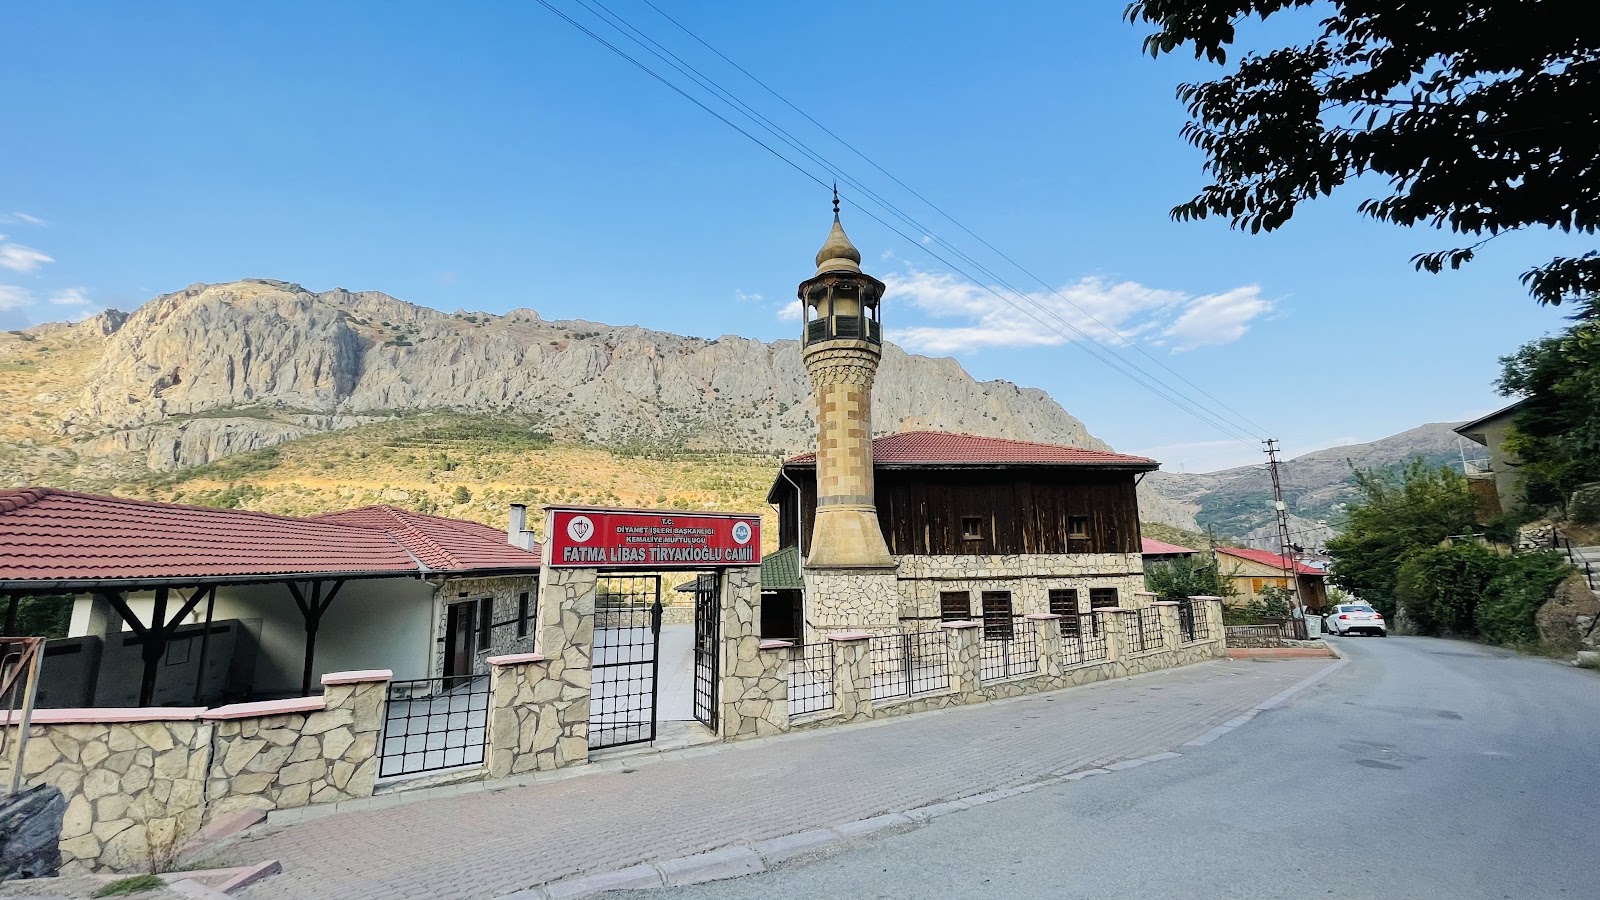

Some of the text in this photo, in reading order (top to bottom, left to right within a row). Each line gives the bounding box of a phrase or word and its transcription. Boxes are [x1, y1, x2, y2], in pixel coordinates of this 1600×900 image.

[616, 526, 648, 534] DİYANET
[650, 526, 673, 535] İŞLERİ
[626, 535, 662, 543] KEMALİYE
[563, 544, 753, 561] FATMA LİBAS TİRYAKİOĞLU CAMİİ
